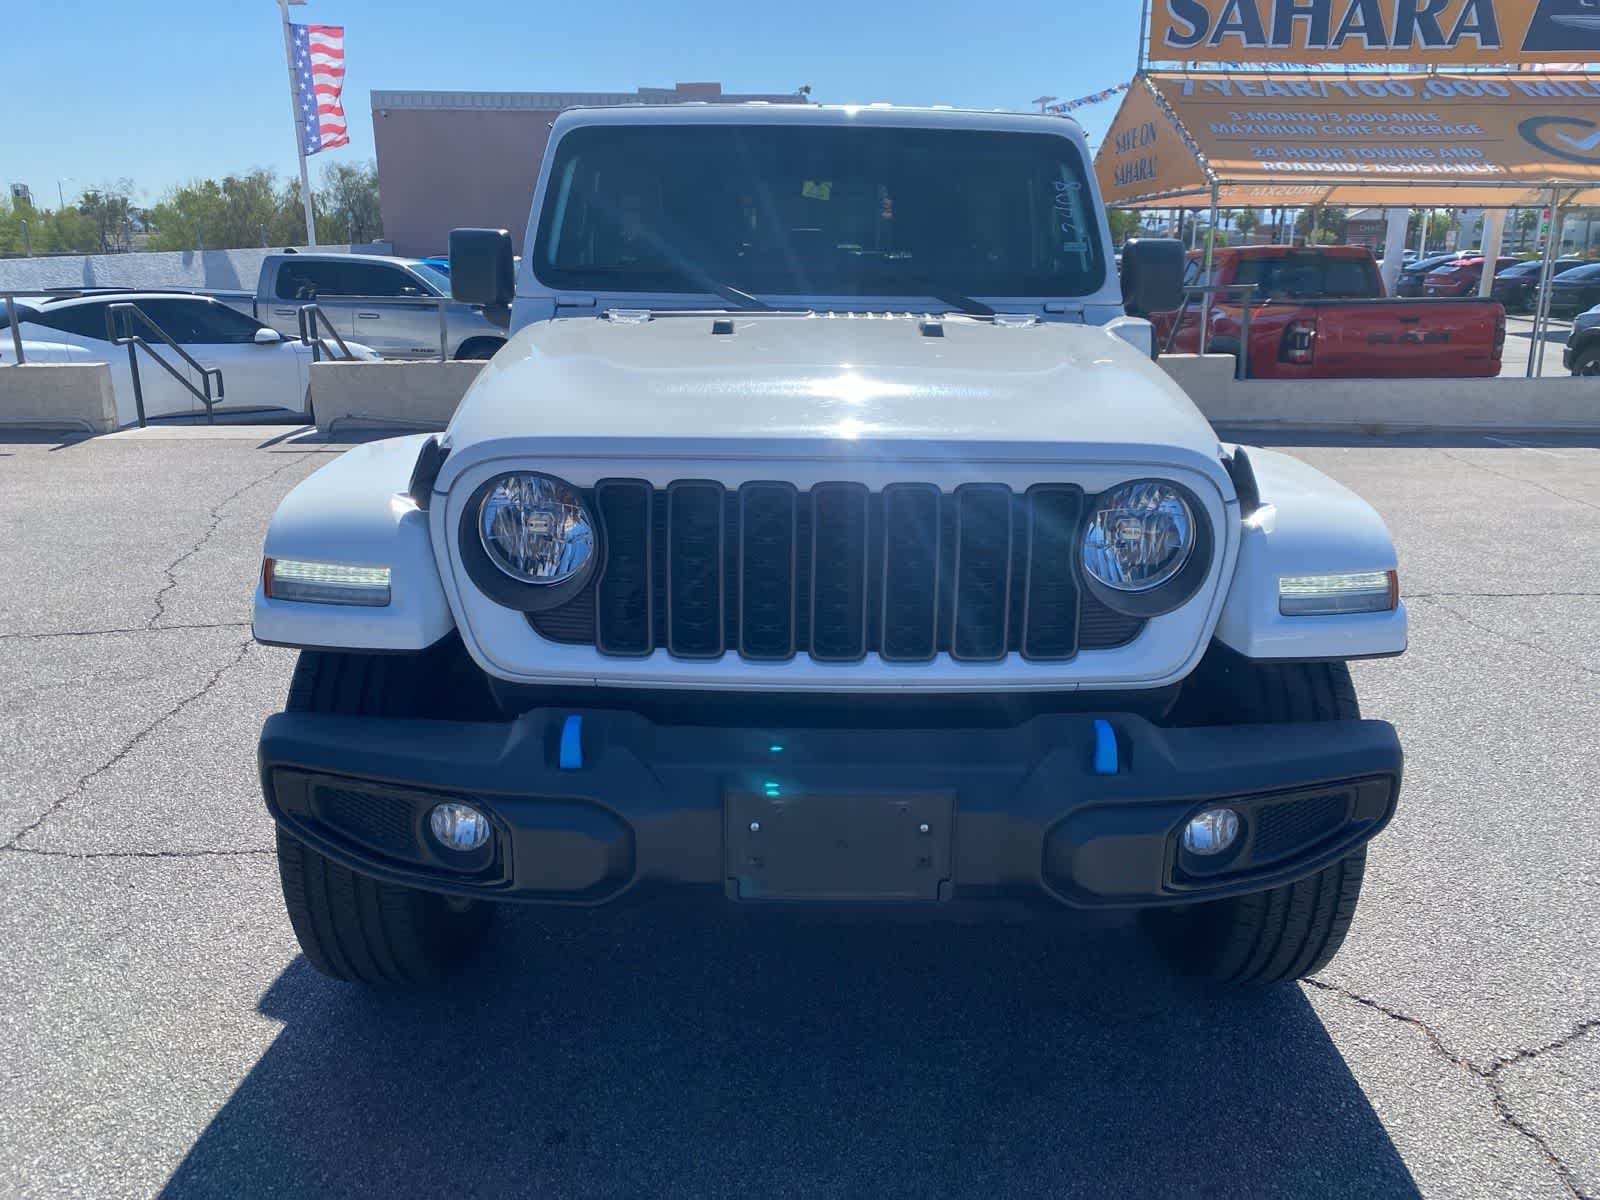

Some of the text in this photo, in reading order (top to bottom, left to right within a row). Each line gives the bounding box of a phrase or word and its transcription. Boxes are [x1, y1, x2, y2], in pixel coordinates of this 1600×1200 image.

[1164, 0, 1501, 49] SAHARA
[1209, 124, 1483, 135] MAXIMUM CARE COVERAGE
[1350, 147, 1436, 158] TOWING
[1439, 147, 1485, 158] AND
[1261, 161, 1500, 173] ROADSIDE ASSISTANCE
